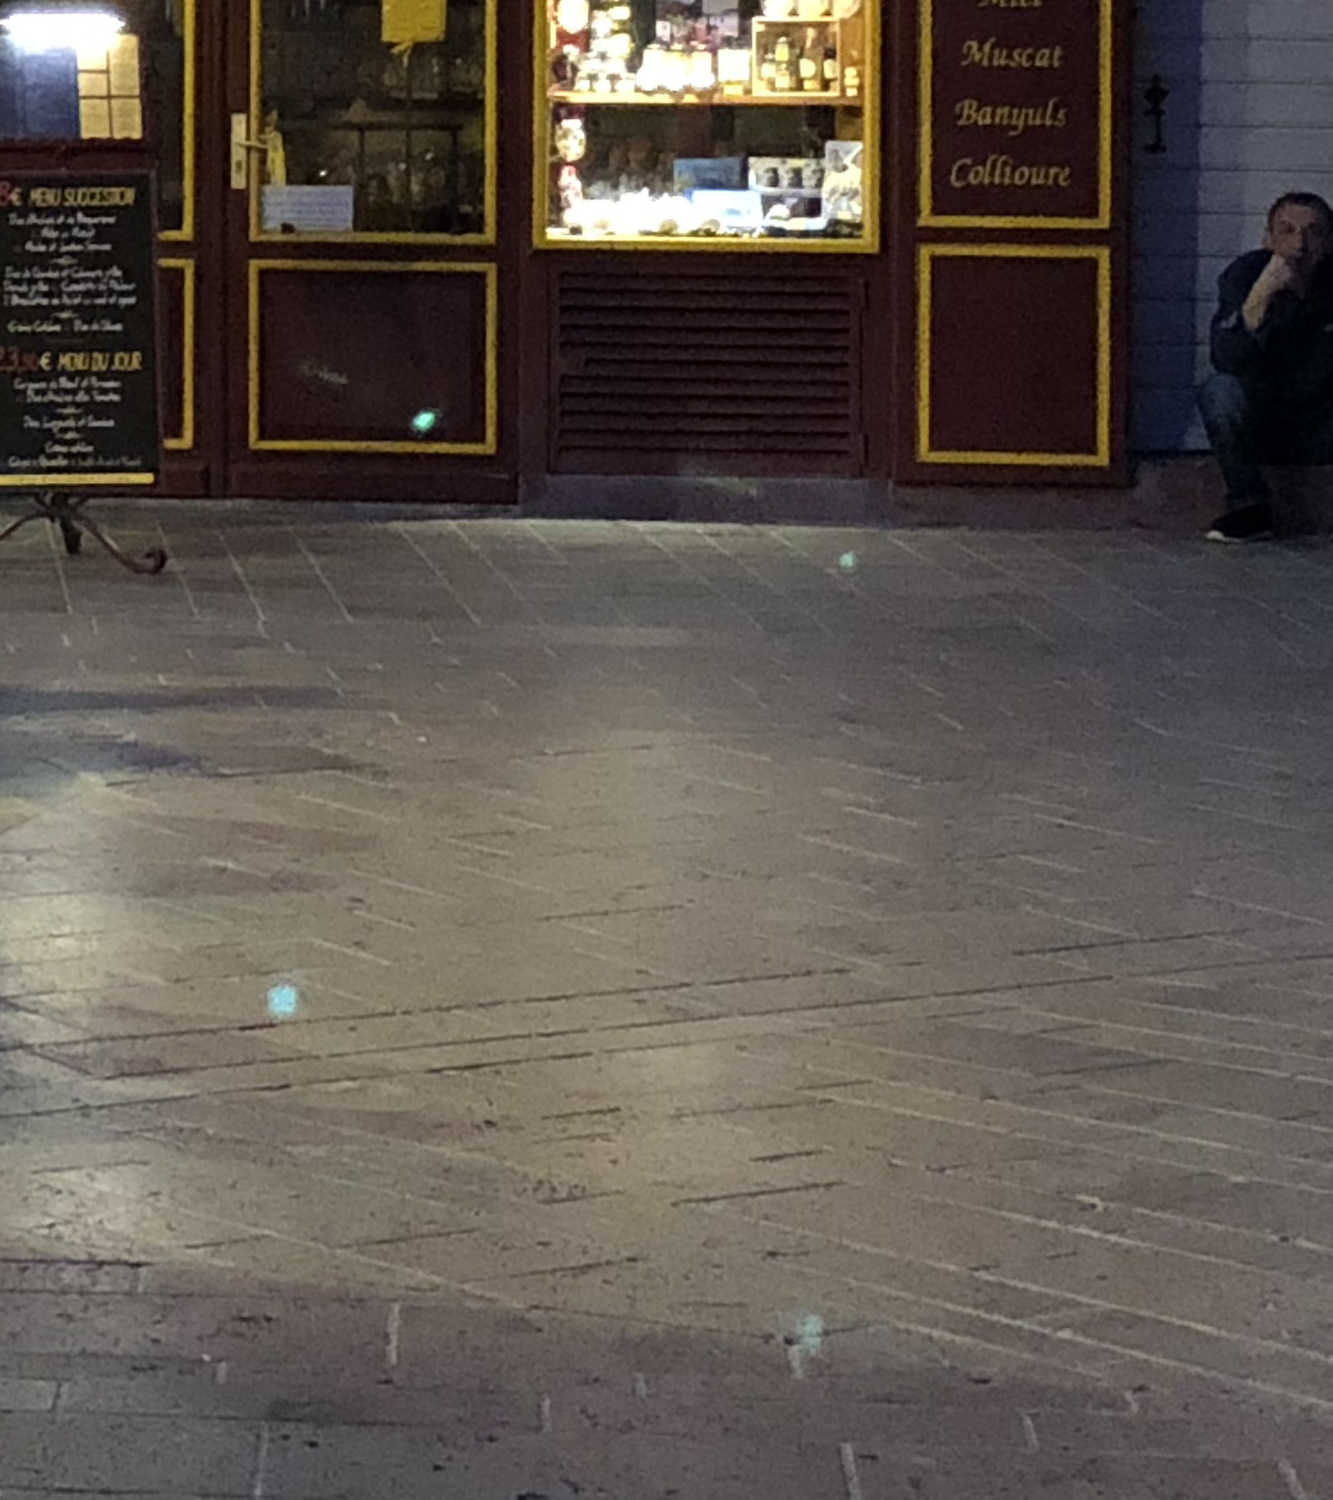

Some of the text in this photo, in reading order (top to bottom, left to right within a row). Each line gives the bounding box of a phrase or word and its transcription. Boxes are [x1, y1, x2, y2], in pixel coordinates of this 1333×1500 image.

[962, 39, 1063, 68] Muscat
[955, 98, 1068, 135] Banyuls
[950, 158, 1072, 187] Collioure
